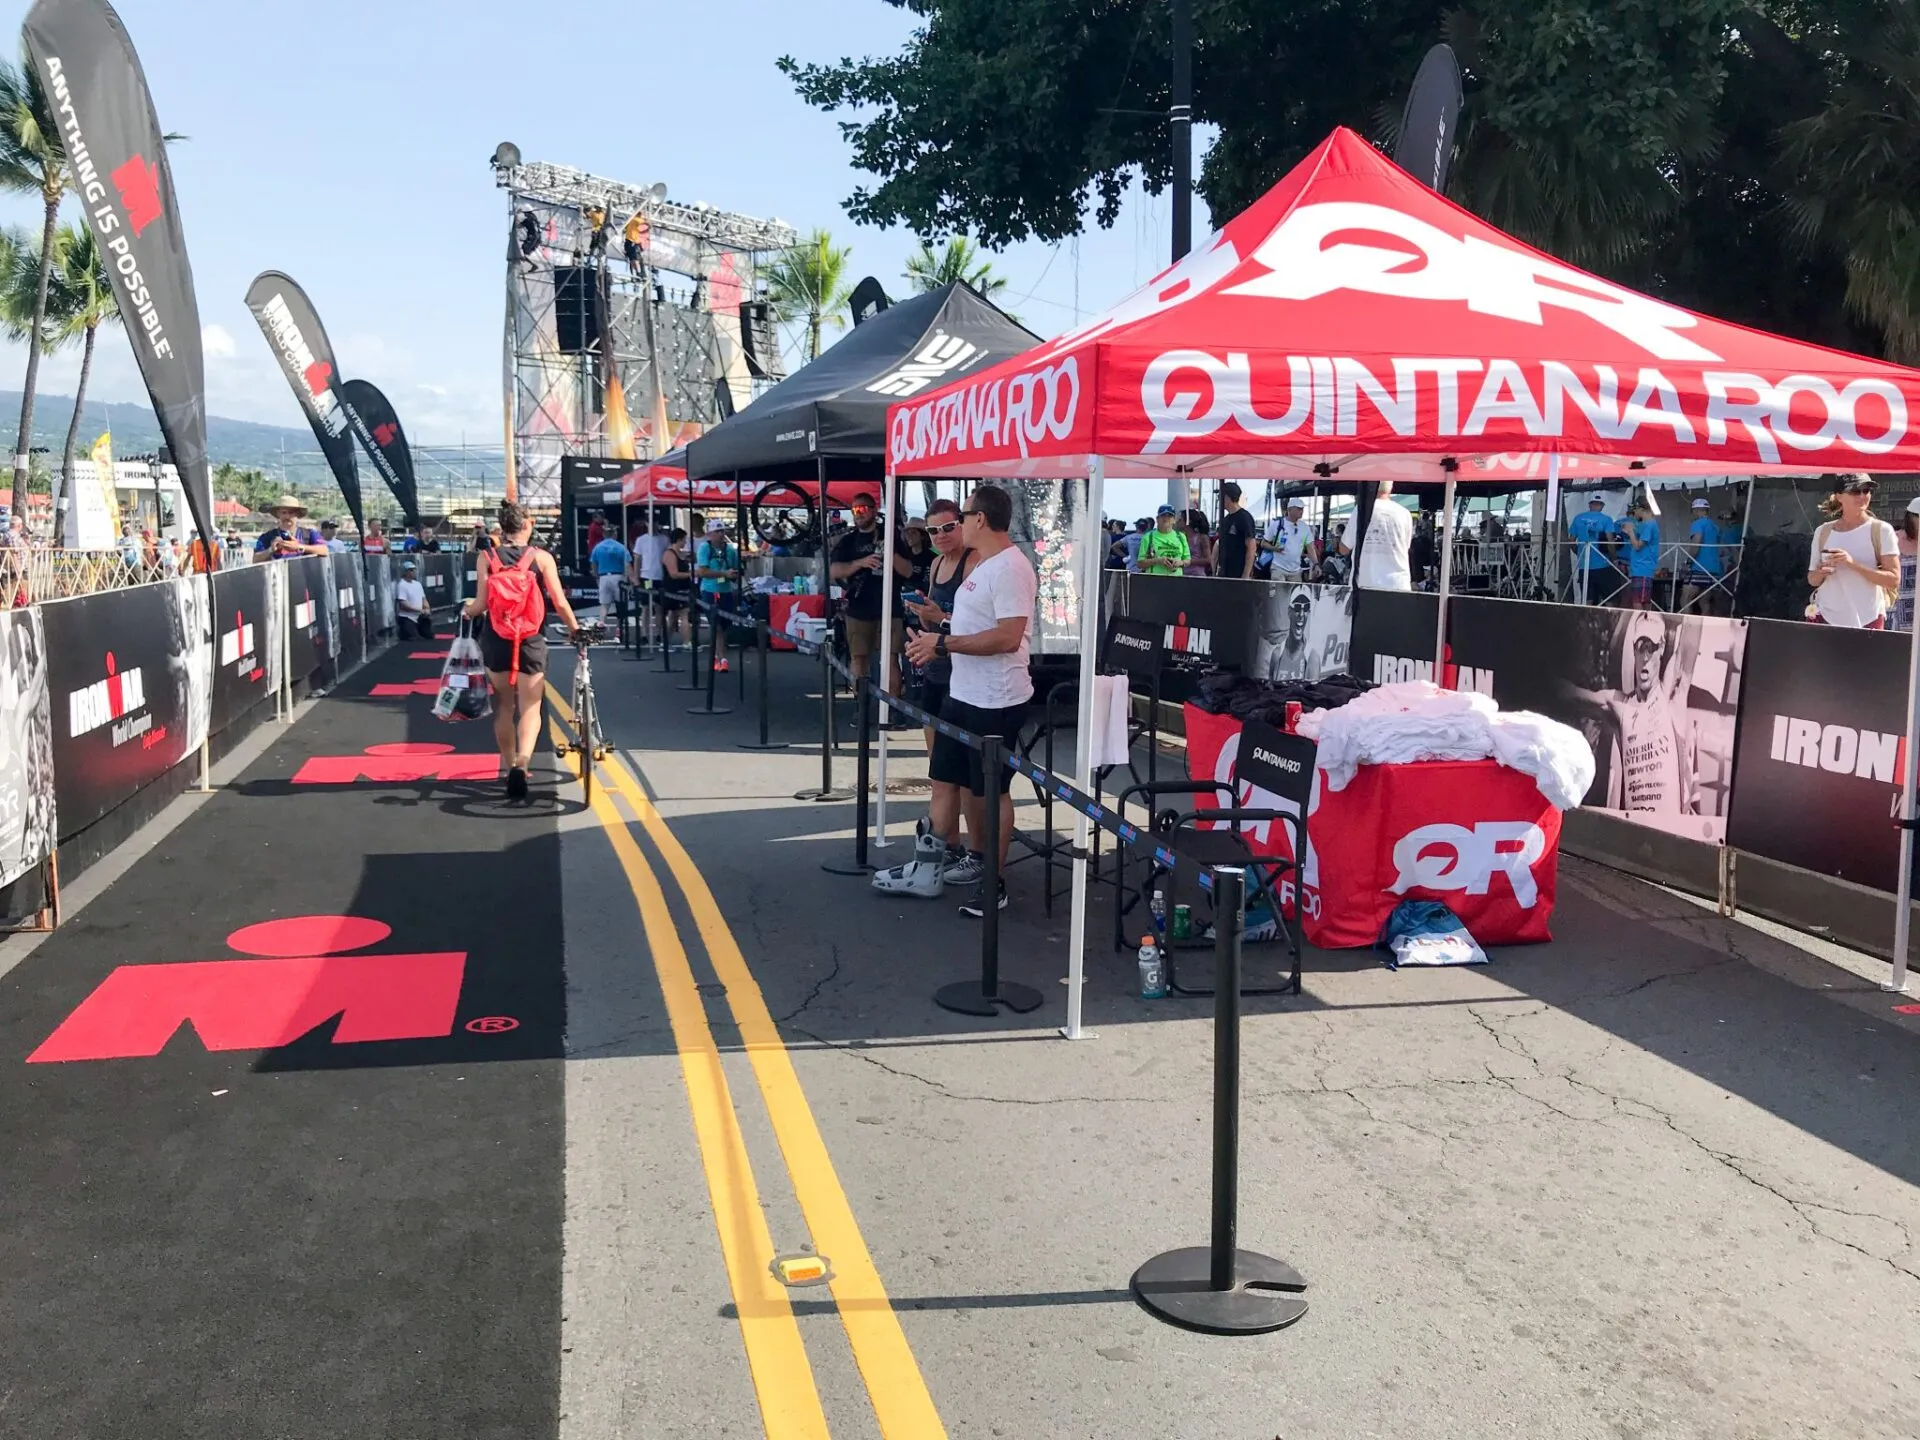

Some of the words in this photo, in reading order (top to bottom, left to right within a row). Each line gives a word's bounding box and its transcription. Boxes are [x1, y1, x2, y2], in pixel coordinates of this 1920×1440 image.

[45, 55, 107, 204] ANYTHING
[94, 204, 120, 236] IS
[262, 304, 287, 354] WORLD
[265, 293, 349, 436] IRONMAN
[346, 402, 372, 443] ANYTHING
[374, 446, 400, 485] POSSIBLE
[891, 378, 1000, 466] QUINTANA
[1003, 356, 1080, 459] ROO
[1140, 349, 1697, 454] QUINTANA
[1706, 375, 1911, 463] ROO
[124, 470, 168, 480] IRONN
[1114, 632, 1139, 649] QUINTANA
[1139, 639, 1152, 651] ROO
[69, 651, 146, 738] IRONMAN
[1252, 747, 1287, 769] QUINTANA
[1286, 760, 1301, 773] ROO
[1770, 714, 1907, 786] IRON
[1382, 820, 1546, 909] QR
